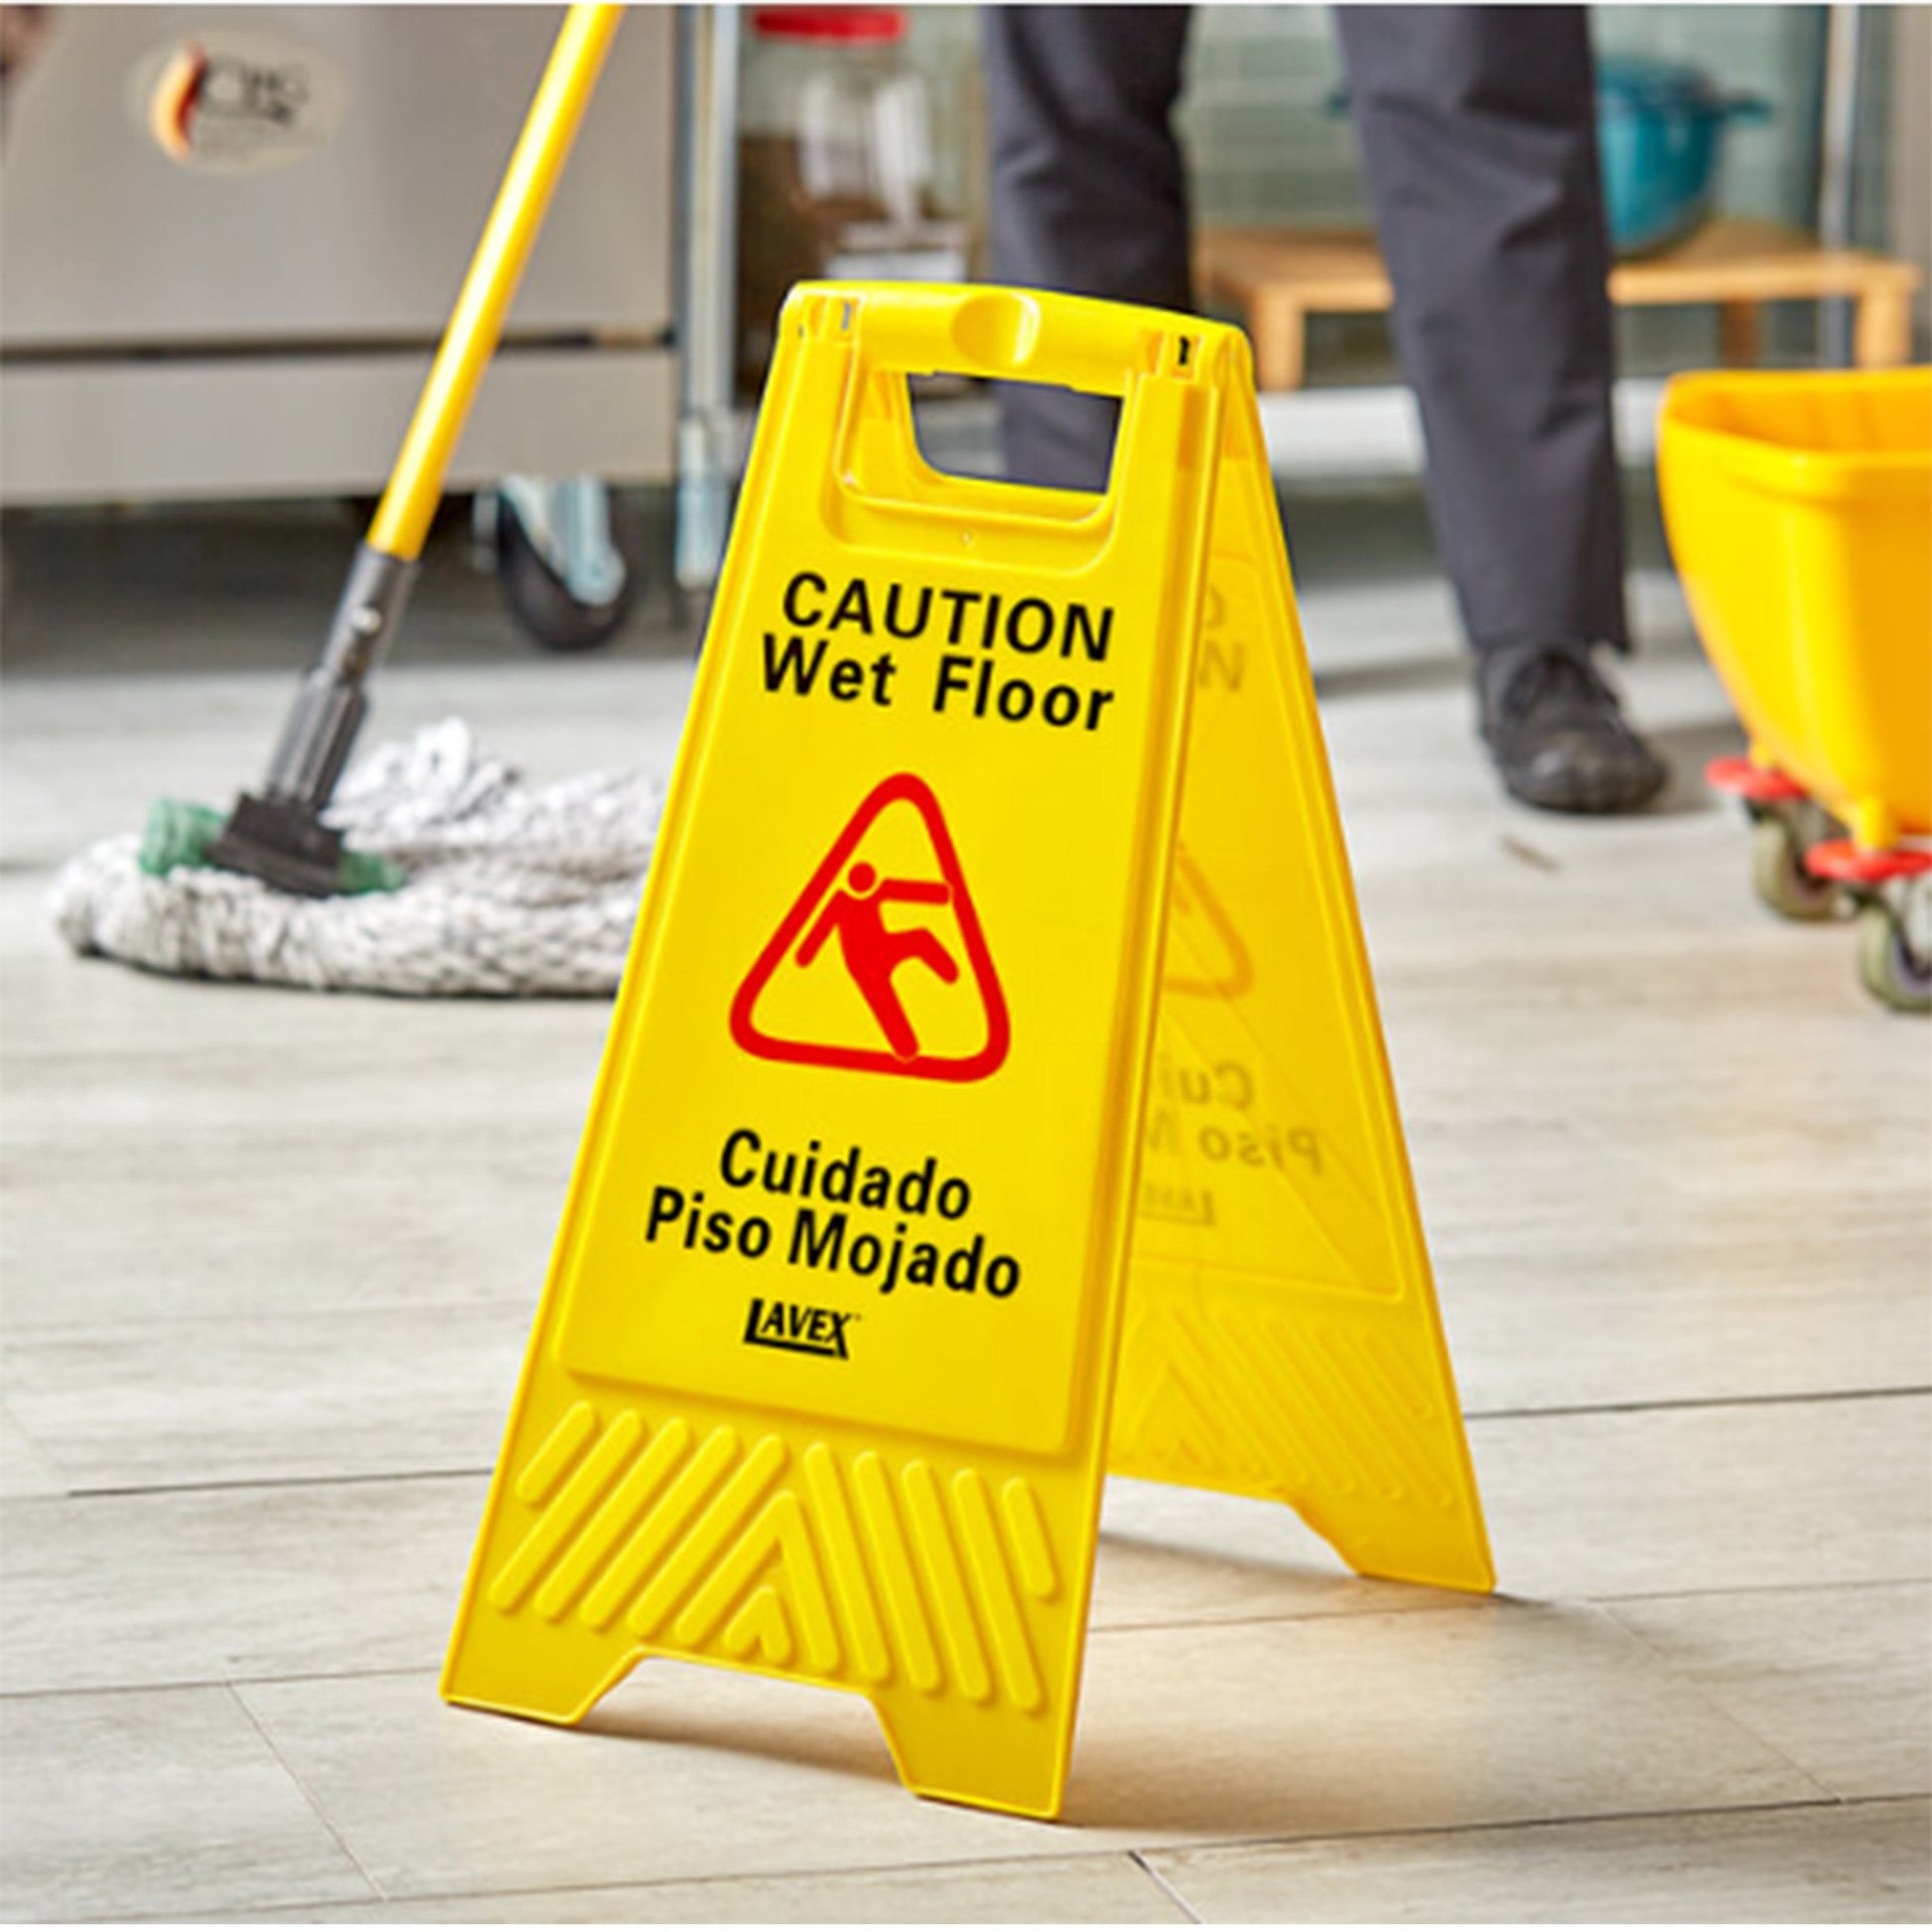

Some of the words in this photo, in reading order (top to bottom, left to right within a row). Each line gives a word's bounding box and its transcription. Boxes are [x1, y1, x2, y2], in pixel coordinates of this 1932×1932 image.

[781, 571, 1114, 661] CAUTION
[762, 633, 897, 708] Wet
[932, 655, 1115, 731] Floor
[721, 1129, 972, 1221] Cuidado
[645, 1185, 772, 1259] Piso
[788, 1209, 1021, 1298] Mojado
[744, 1298, 852, 1360] LAVEX
